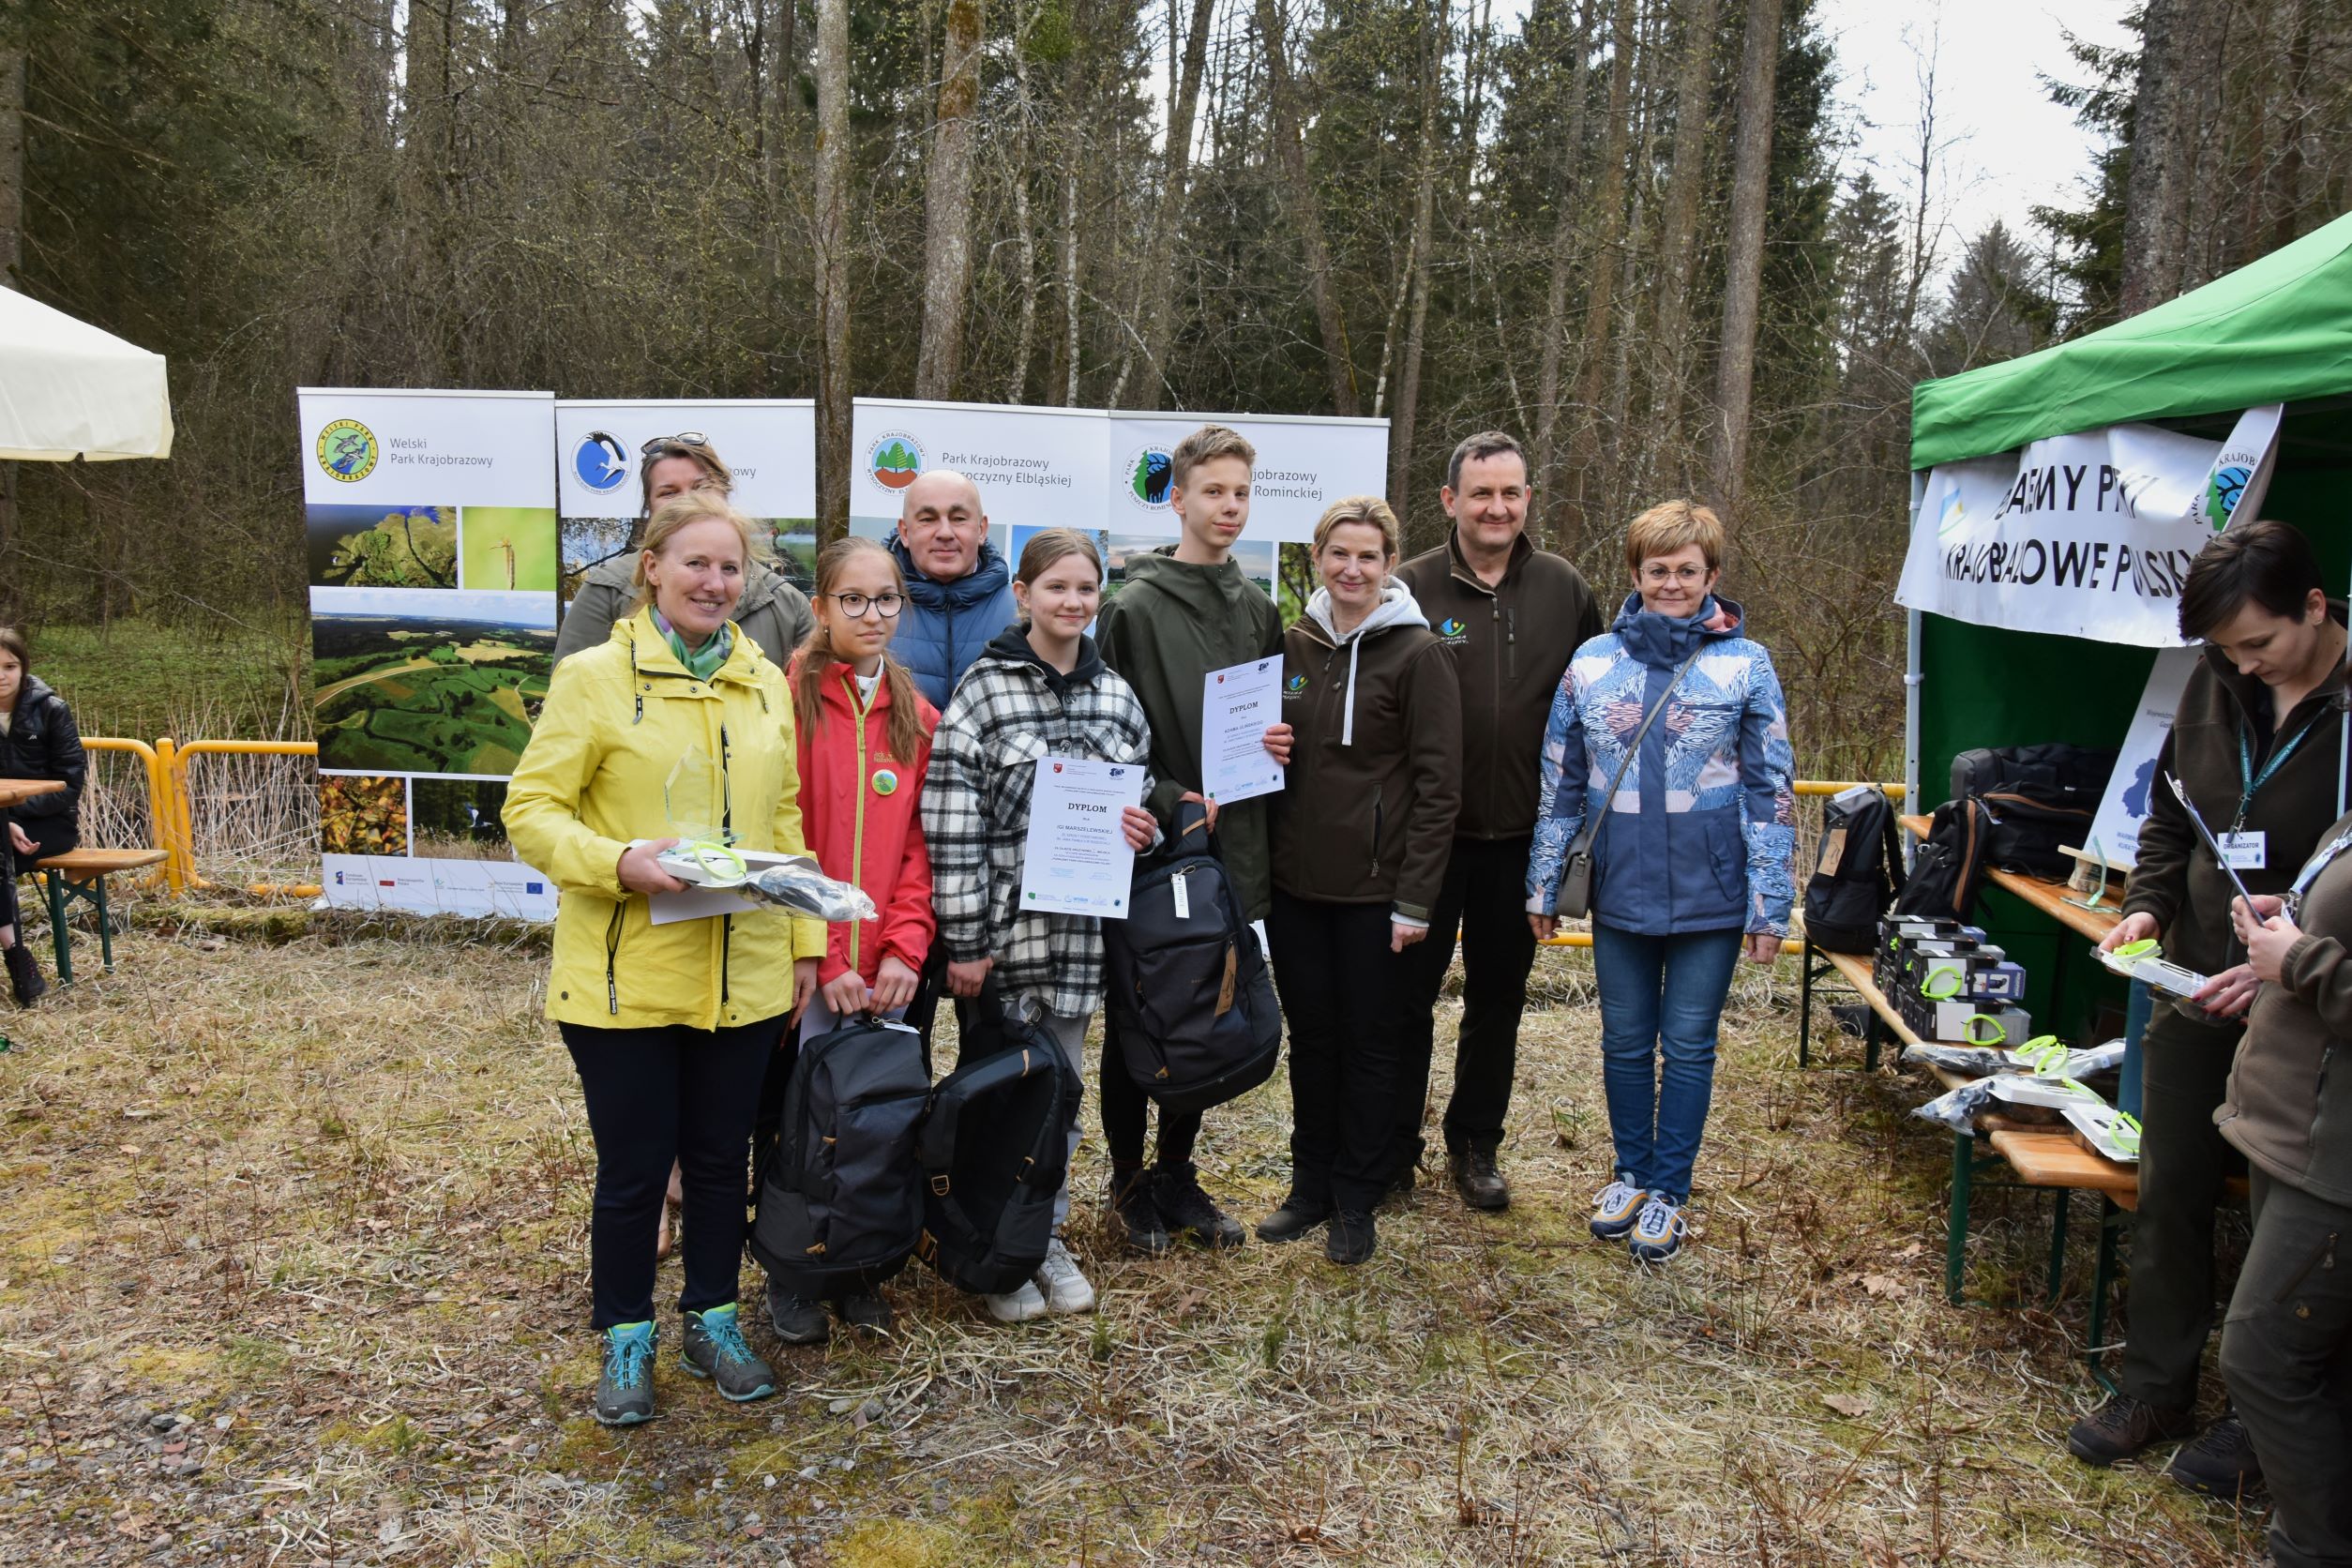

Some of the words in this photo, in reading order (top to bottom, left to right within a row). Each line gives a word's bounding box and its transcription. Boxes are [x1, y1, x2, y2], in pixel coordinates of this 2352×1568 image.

[389, 438, 428, 449] Welski
[867, 440, 881, 455] PARK
[882, 431, 927, 458] KRAJOBRAZOWY
[390, 453, 415, 464] Park
[417, 454, 493, 469] Krajobrazowy
[942, 452, 968, 465] Park
[970, 454, 1050, 472] Krajobrazowy
[1124, 458, 1136, 475] PARK
[2217, 451, 2258, 467] KRAJOB
[867, 467, 897, 494] WYSOCZYZNY
[1016, 472, 1072, 489] Elbląskiej
[1252, 467, 1318, 486] jobrazowy
[1127, 490, 1150, 510] PUSZCZY
[1254, 485, 1323, 502] Rominckiej
[1229, 701, 1259, 715] DYPLOM
[1067, 803, 1108, 813] DYPLOM
